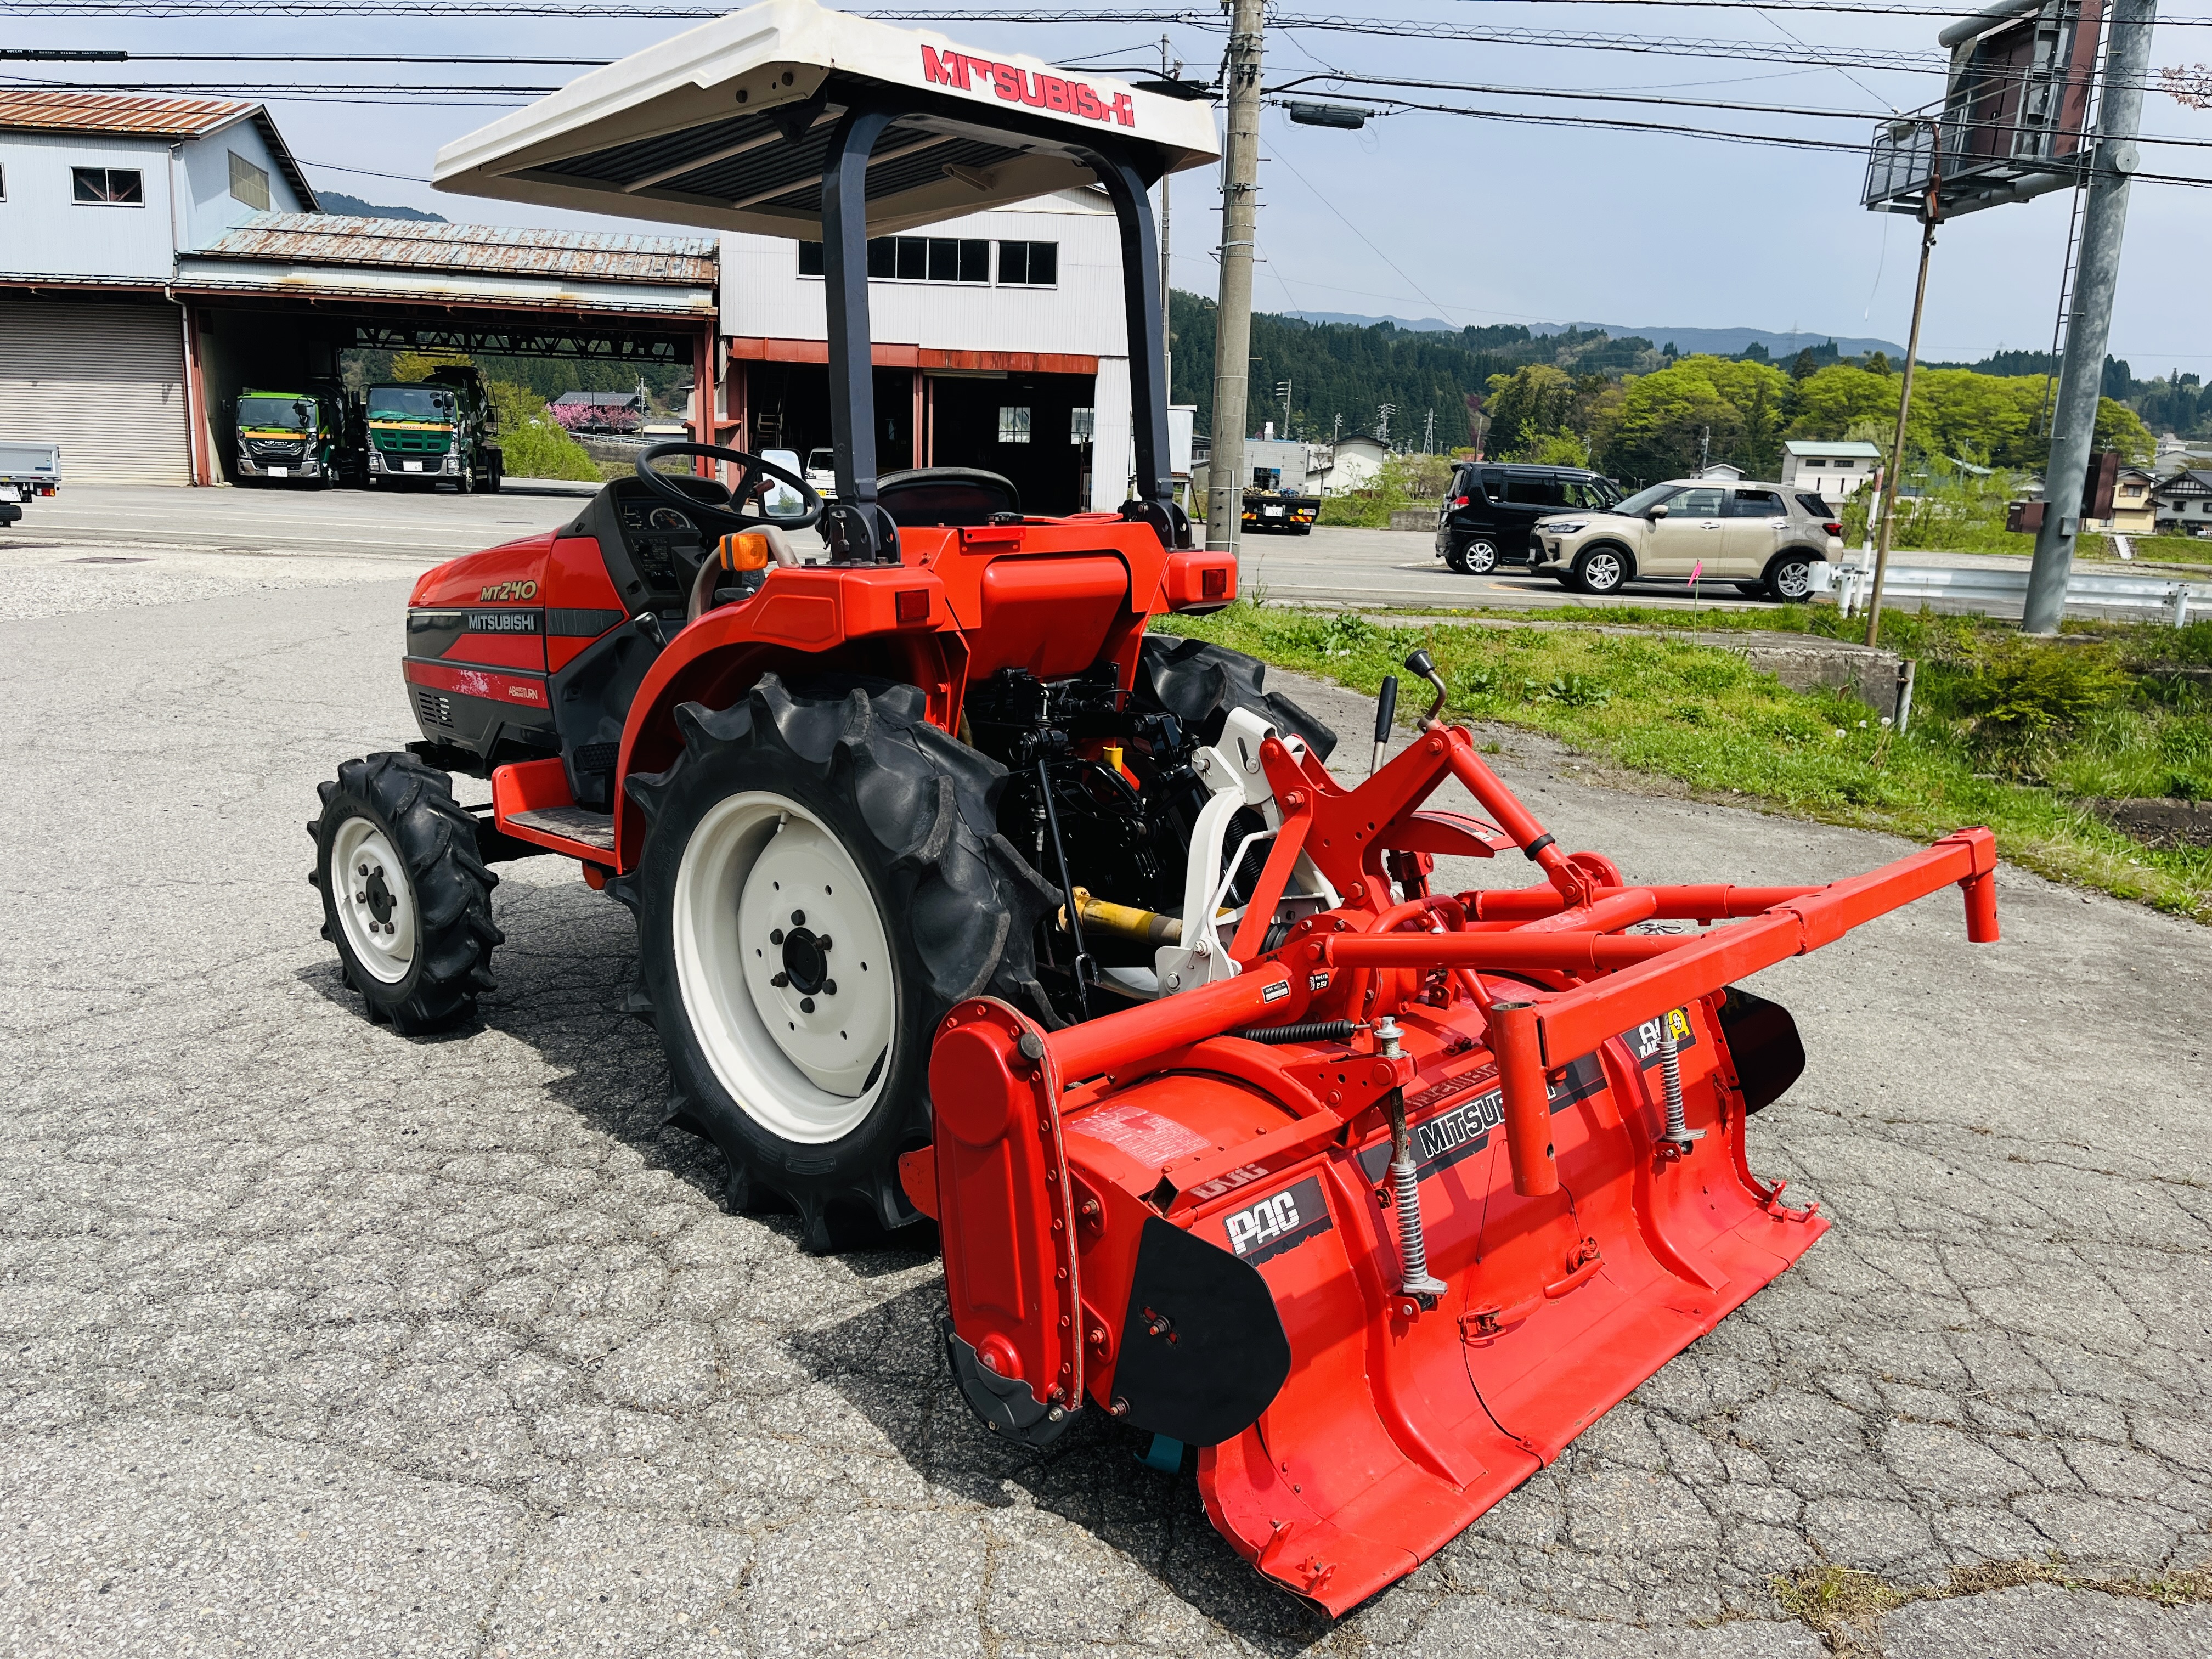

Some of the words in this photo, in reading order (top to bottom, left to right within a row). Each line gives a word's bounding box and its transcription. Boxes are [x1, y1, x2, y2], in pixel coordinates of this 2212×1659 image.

[921, 44, 1135, 128] MITSUBISHI
[480, 579, 538, 602] MT240
[469, 615, 535, 631] MITSUBISHI
[1225, 1191, 1300, 1255] PAC
